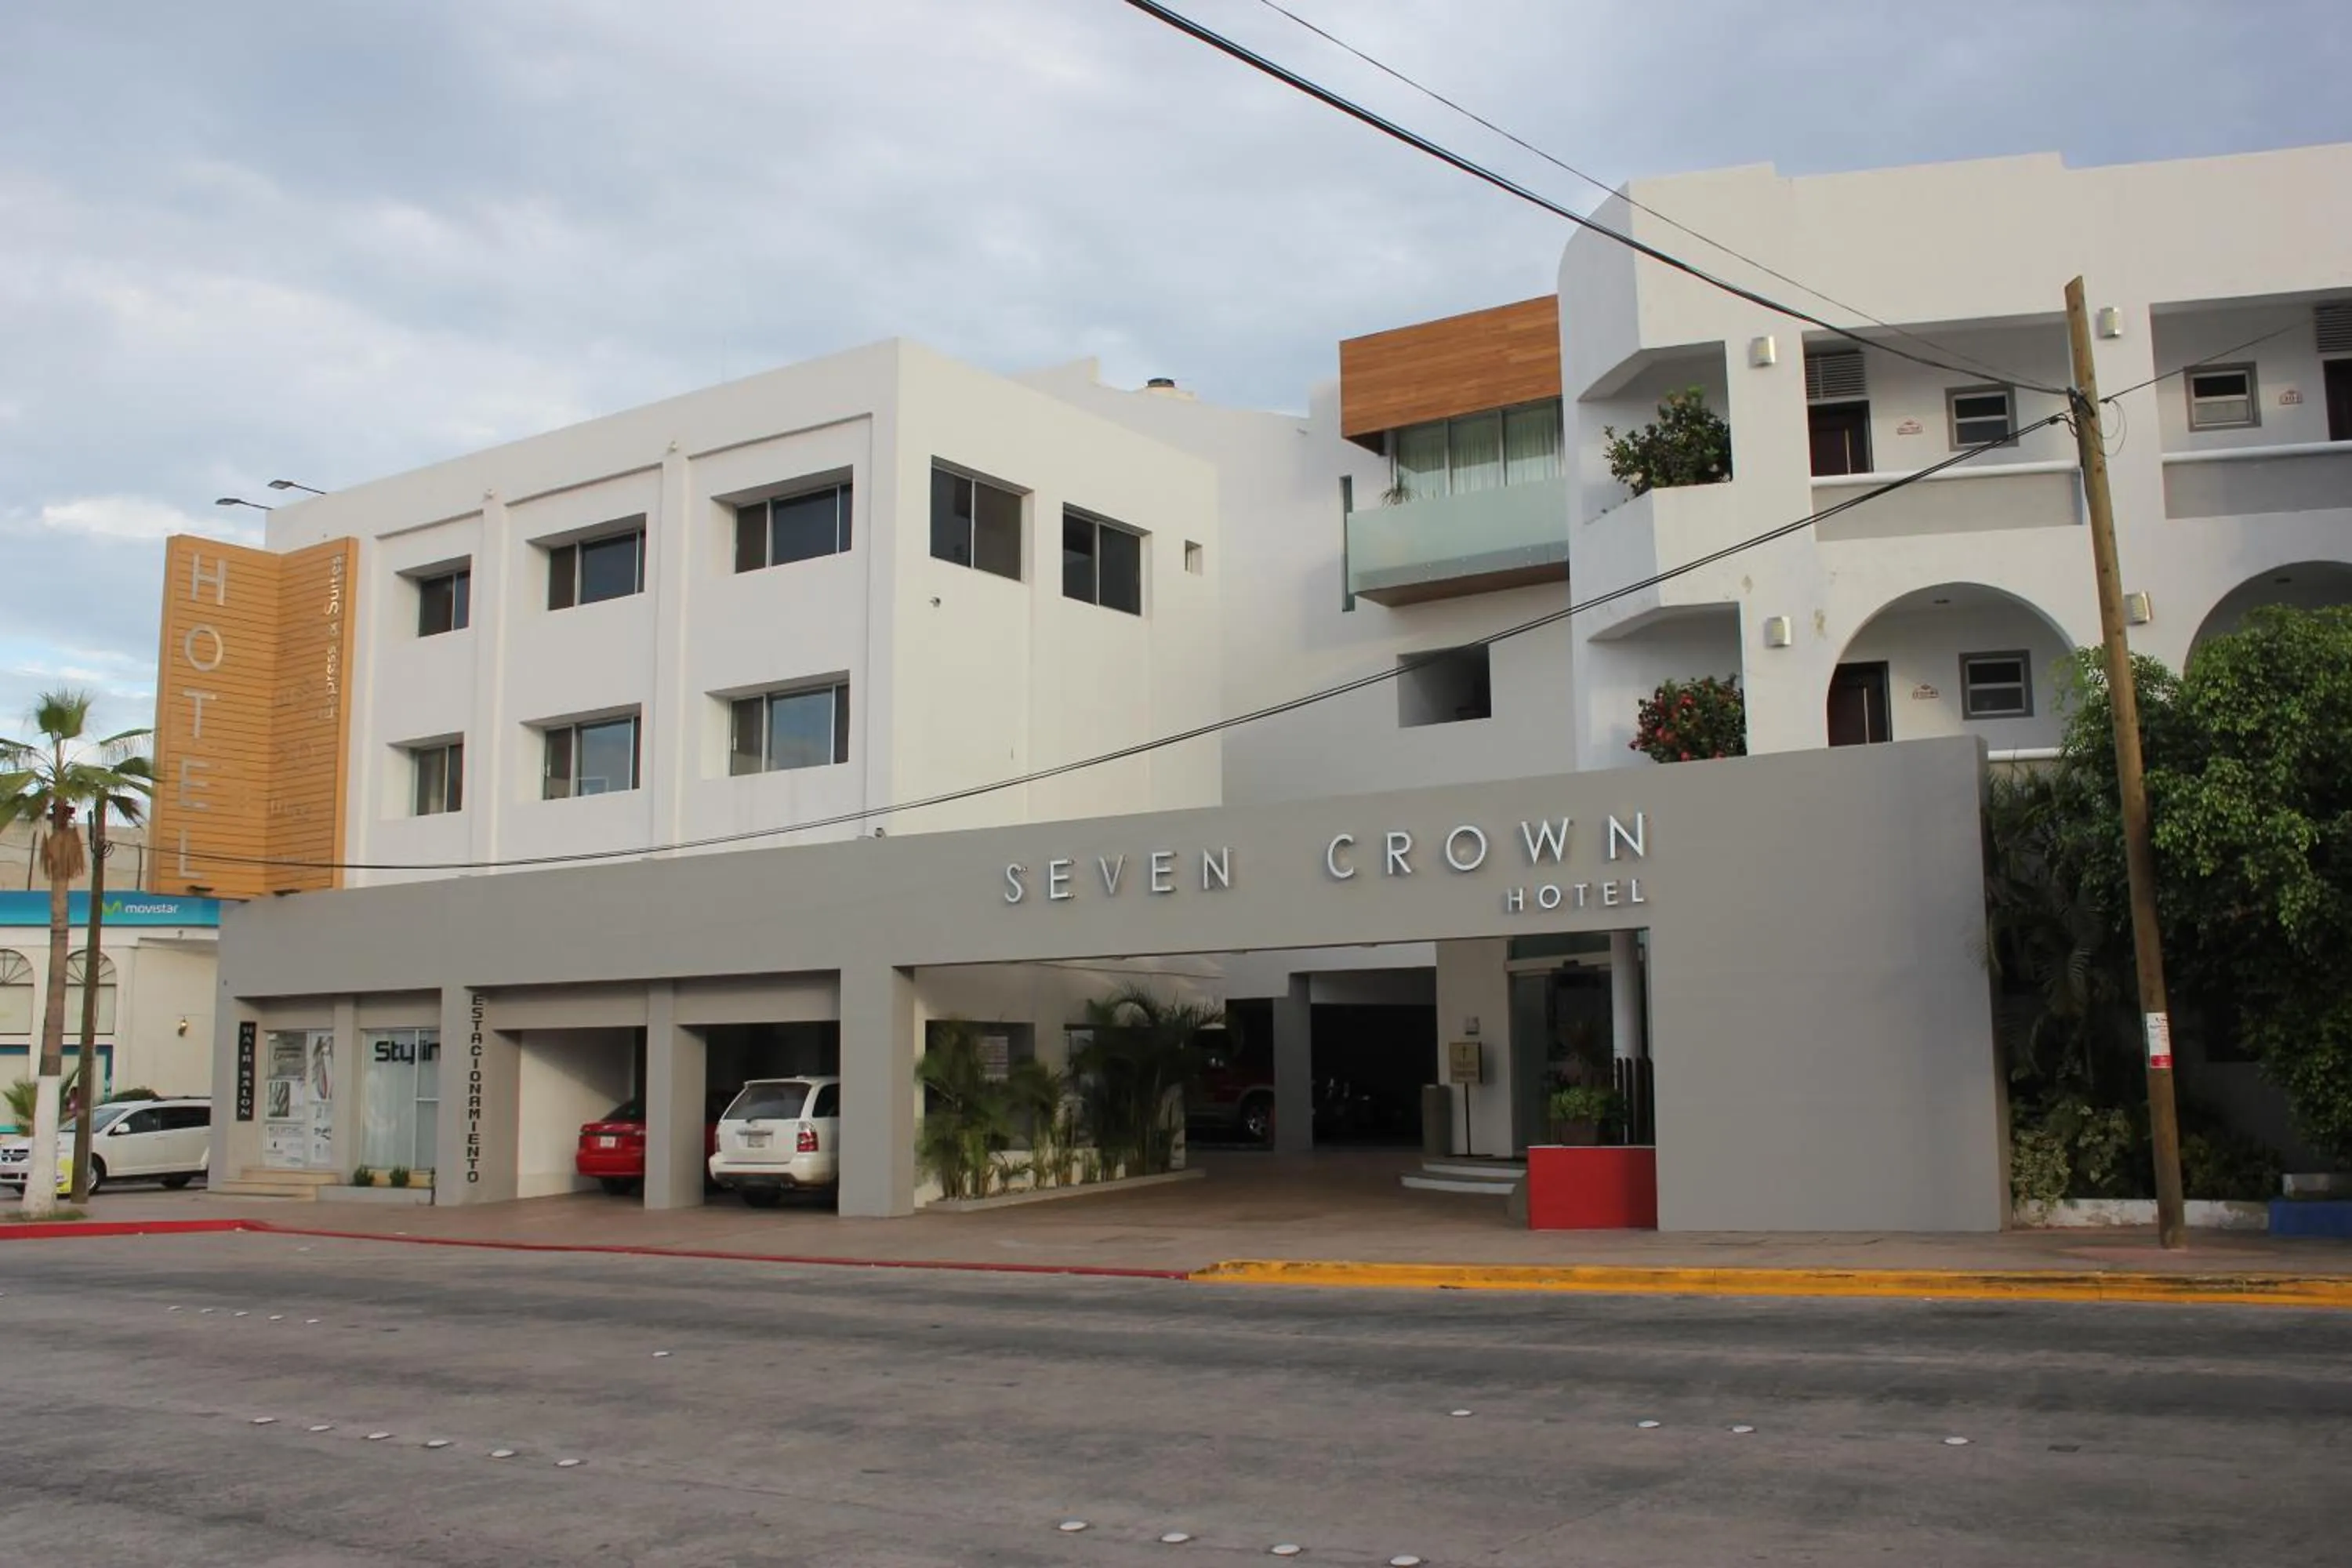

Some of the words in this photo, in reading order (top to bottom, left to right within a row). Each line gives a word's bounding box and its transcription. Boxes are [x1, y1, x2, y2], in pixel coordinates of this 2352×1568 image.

[325, 555, 342, 615] Suites
[178, 553, 226, 879] HOTEL
[320, 645, 337, 720] Express
[1005, 847, 1229, 902] SEVEN
[1327, 812, 1644, 879] CROWN
[125, 903, 180, 913] movistar
[1508, 880, 1644, 912] HOTEL
[240, 1070, 251, 1116] SALON
[466, 994, 484, 1183] ESTACIONAMIENTO
